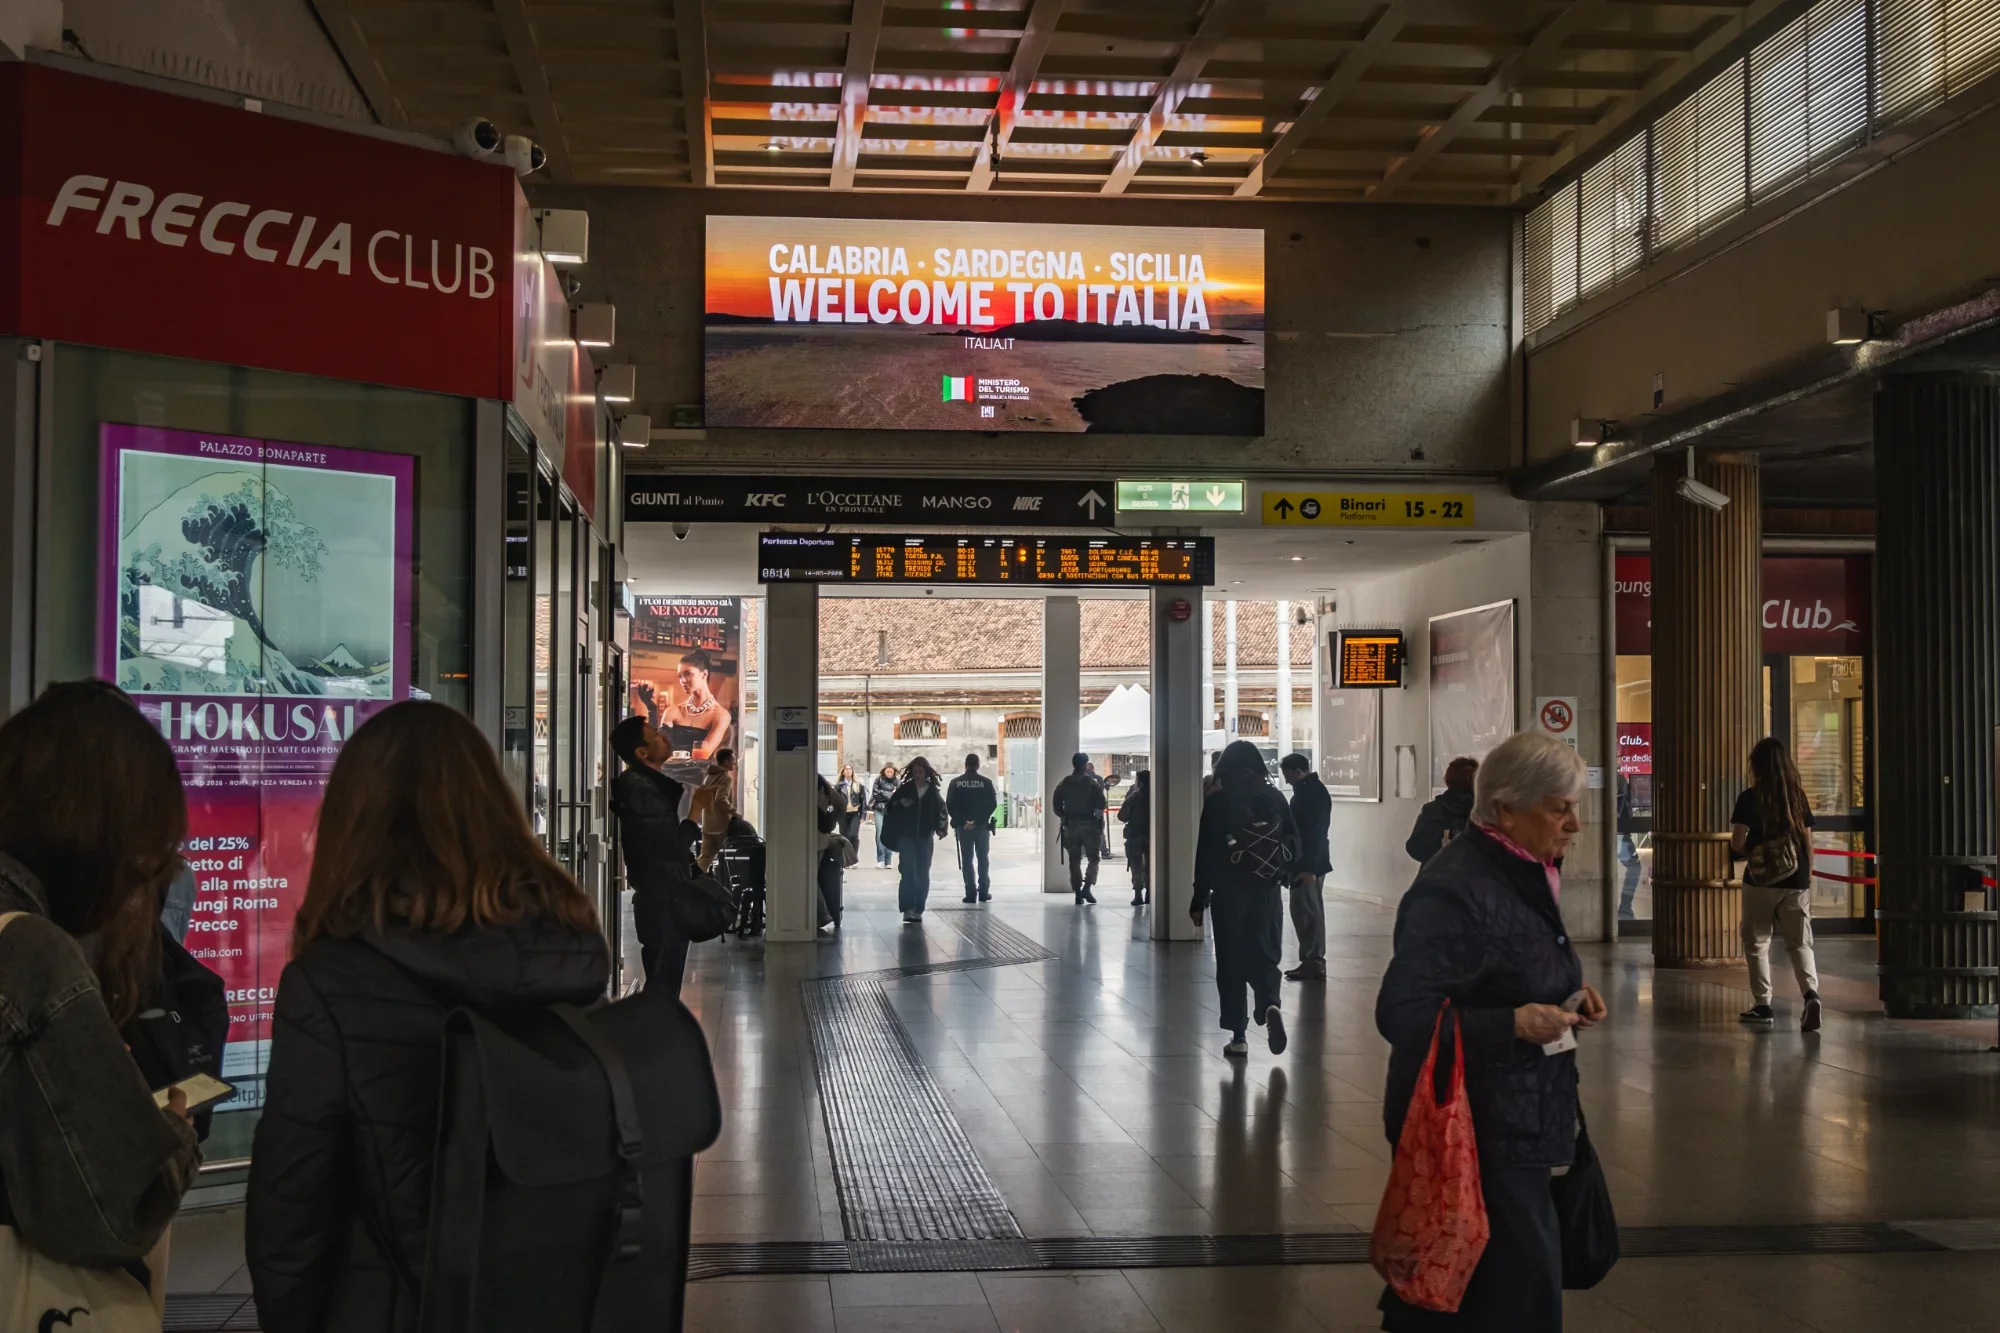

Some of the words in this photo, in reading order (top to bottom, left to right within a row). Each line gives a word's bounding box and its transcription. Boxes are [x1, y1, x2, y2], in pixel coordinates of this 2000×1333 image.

[47, 174, 352, 275] FRECCIA
[367, 230, 496, 299] CLUB
[769, 243, 909, 275] CALABRIA
[934, 248, 1086, 280] SARDEGNA
[1109, 252, 1206, 283] SICILIA
[769, 277, 995, 326] WELCOME
[1007, 281, 1065, 322] TO
[1078, 284, 1210, 330] ITALIA
[964, 337, 1015, 351] ITALIA.IT
[978, 379, 1020, 387] MINISTERO
[200, 441, 253, 456] PALAZZO
[258, 447, 327, 464] BONAPARTE
[630, 492, 680, 506] GIUNTI
[683, 495, 692, 506] al
[695, 495, 724, 507] Punto
[744, 493, 786, 507] KFC
[922, 495, 992, 509] MANGO
[1012, 496, 1044, 511] NIKE
[1340, 498, 1386, 511] Binari
[839, 506, 885, 514] PROVENCE
[1340, 512, 1377, 521] Platforms
[1405, 501, 1425, 518] 15
[1442, 501, 1464, 518] 22
[762, 537, 798, 545] Partenze
[799, 538, 835, 547] Departures
[762, 568, 790, 579] 08:14
[643, 598, 662, 606] TUOI
[662, 598, 697, 606] DESIDERI
[697, 598, 719, 606] SONO
[719, 598, 733, 606] GIÀ
[650, 605, 671, 616] NEI
[673, 605, 719, 616] NEGOZI
[1762, 599, 1832, 629] Club
[688, 616, 726, 625] STAZIONE.
[160, 701, 354, 741] HOKUSAI
[1619, 735, 1643, 745] Club
[211, 745, 253, 754] MAESTRO
[255, 745, 299, 754] DELL'ARTE
[956, 780, 985, 789] POLIZIA
[189, 836, 214, 851] del
[218, 836, 249, 850] 25%
[228, 856, 243, 871] di
[201, 877, 229, 891] alla
[233, 876, 289, 890] mostra
[233, 896, 279, 910] Roma
